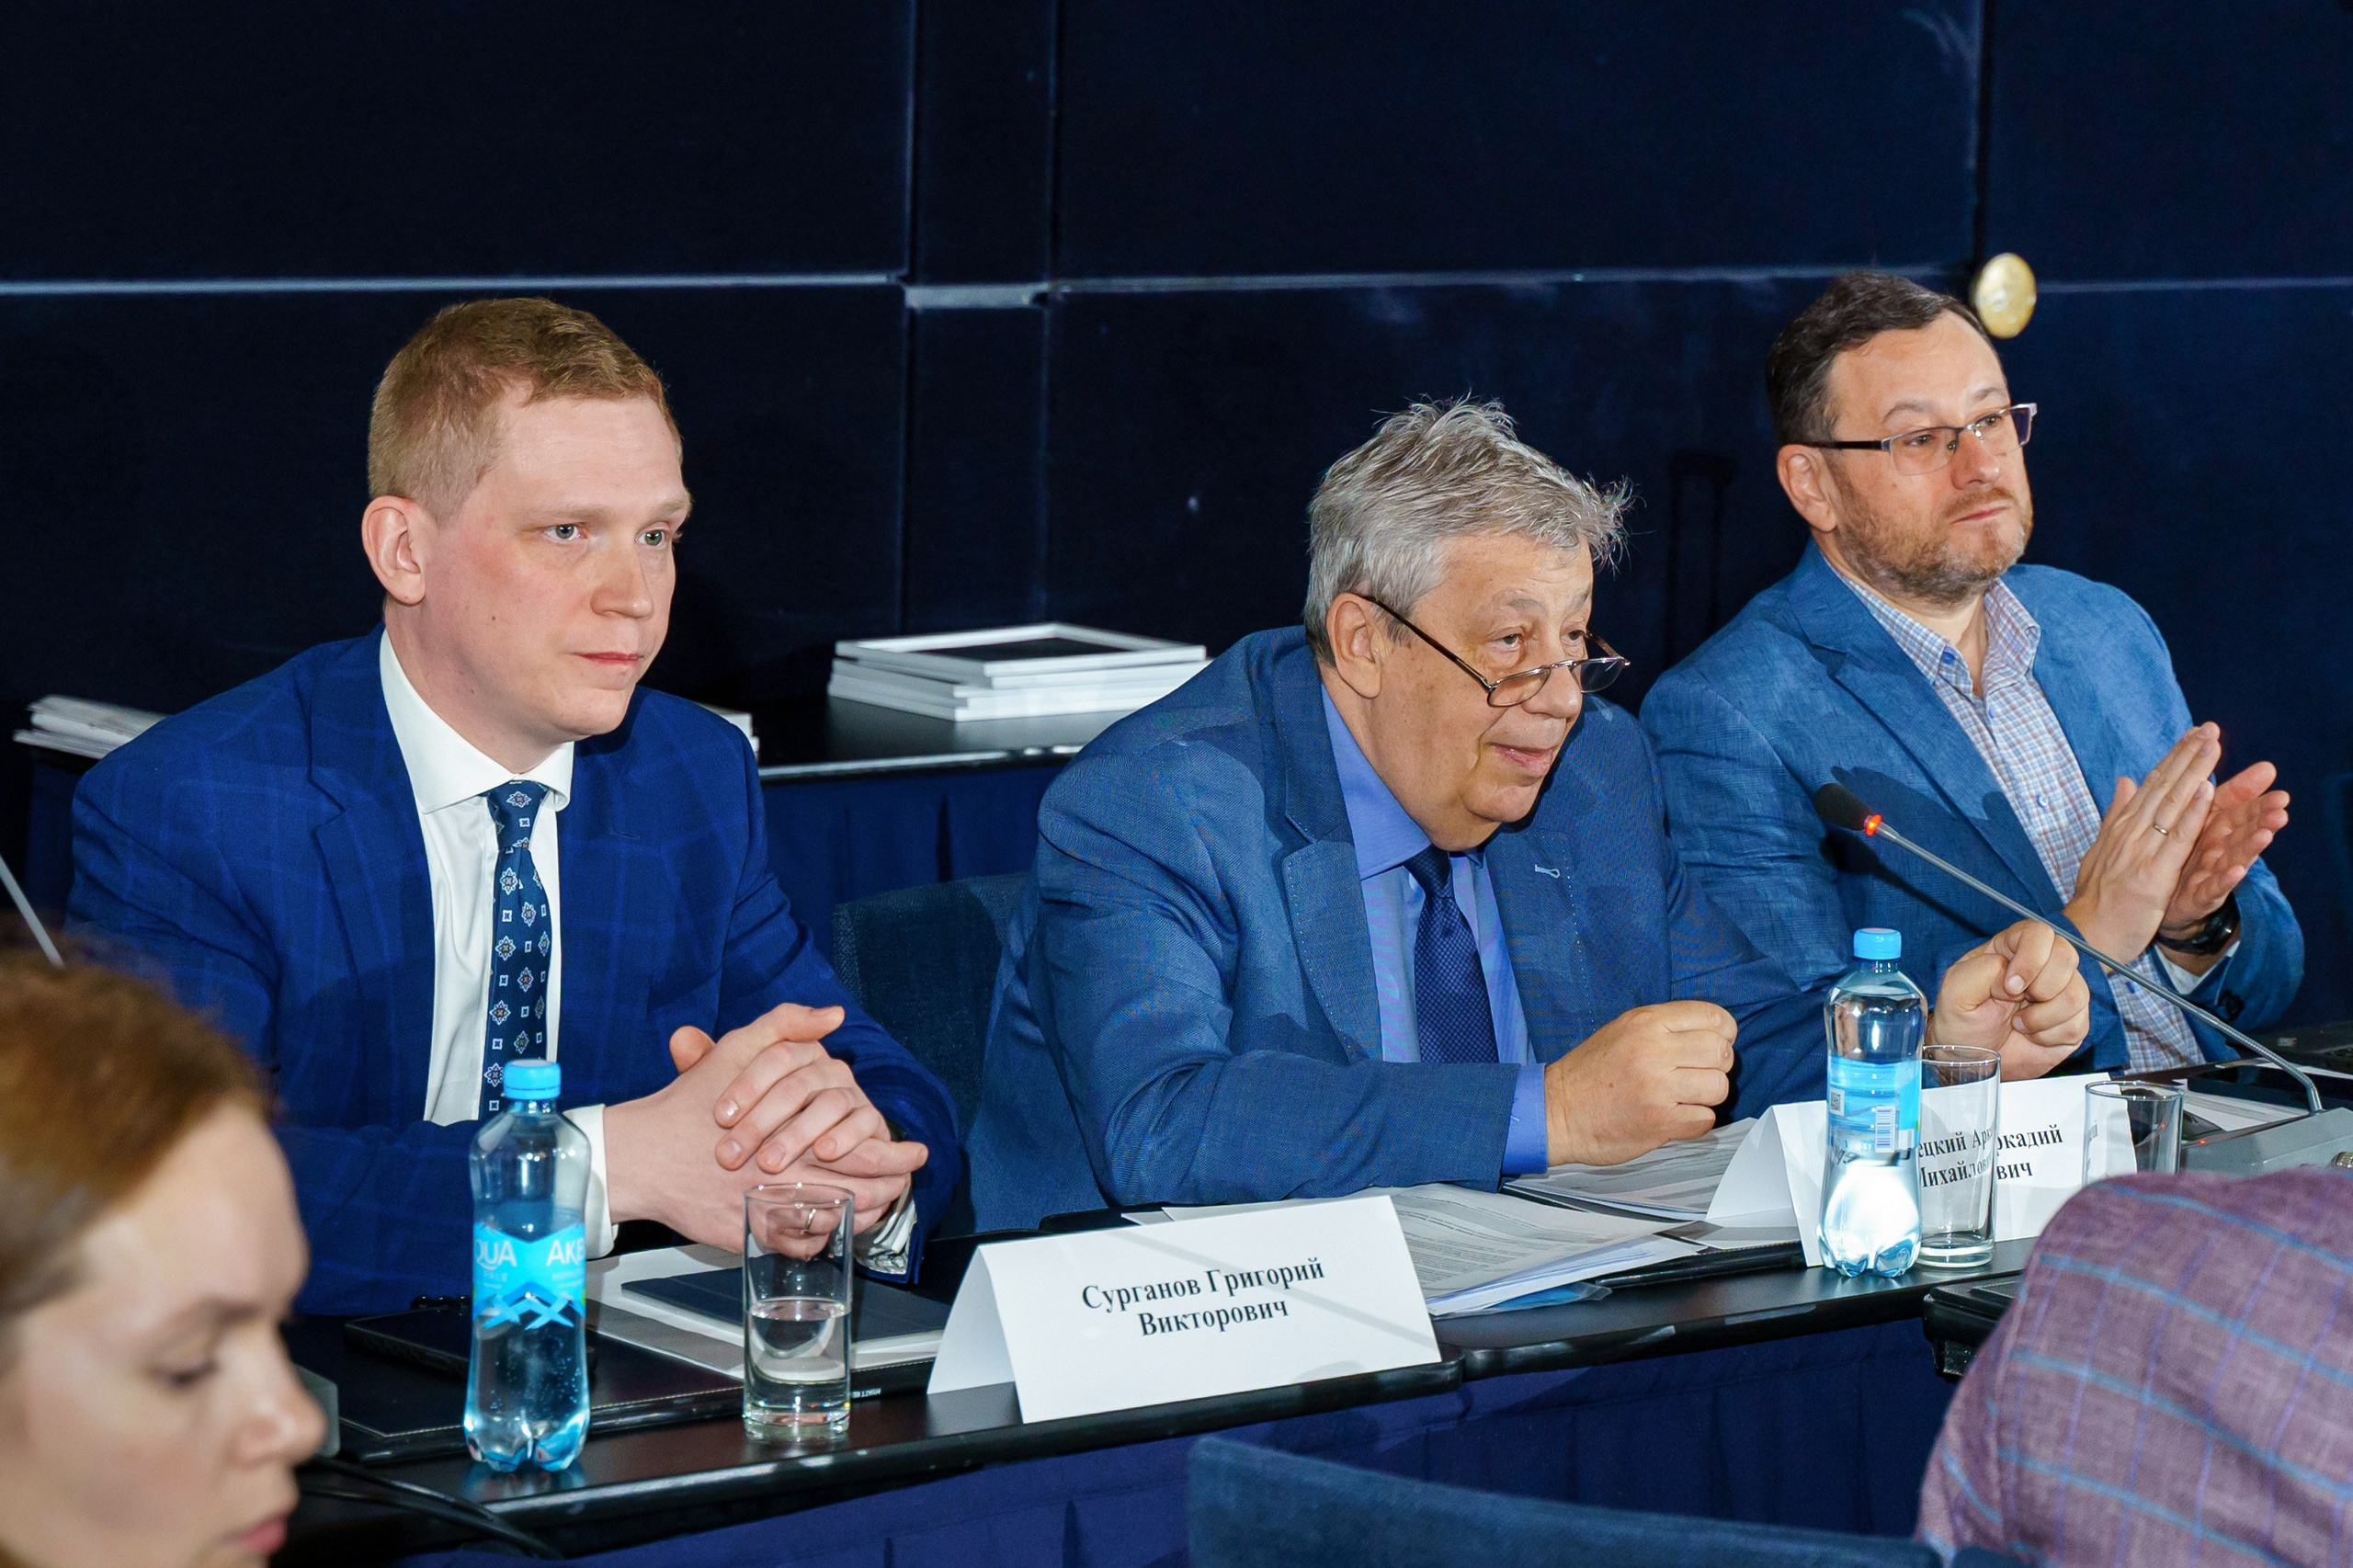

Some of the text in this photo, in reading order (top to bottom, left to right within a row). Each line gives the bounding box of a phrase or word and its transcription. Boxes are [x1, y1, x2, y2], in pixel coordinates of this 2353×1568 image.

[1918, 1131, 1967, 1159] ецкий
[474, 1239, 517, 1270] QUA
[1082, 1257, 1324, 1313] Сурганов Григорий
[1137, 1301, 1289, 1336] Викторович
